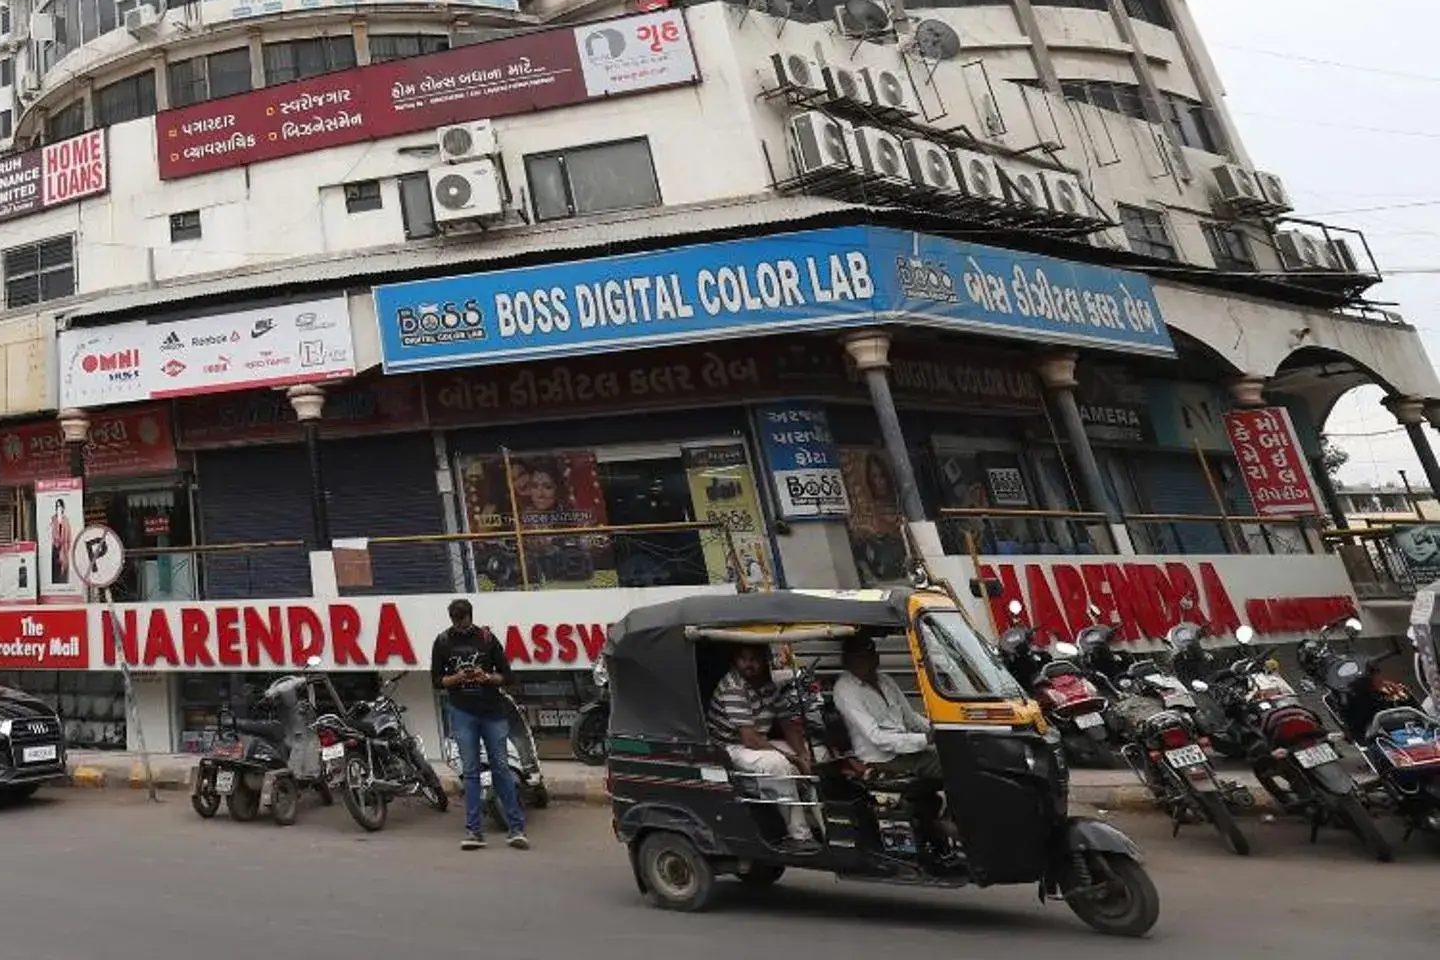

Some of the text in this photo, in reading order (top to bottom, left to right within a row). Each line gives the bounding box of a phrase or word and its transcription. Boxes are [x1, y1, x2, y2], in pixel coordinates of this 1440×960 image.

[280, 88, 352, 115] સ્વરોજગાર
[182, 114, 236, 135] પગારદાર
[47, 134, 101, 174] HOME
[47, 161, 103, 201] LOANS
[495, 250, 876, 337] BOSS DIGITAL COLOR LAB
[82, 348, 139, 373] OMNI
[437, 377, 500, 411] બોસ
[629, 365, 696, 395] કલર
[700, 352, 759, 387] લેબ
[1079, 405, 1140, 426] AMERA
[980, 562, 1242, 648] NARENDRA
[21, 616, 44, 636] The
[102, 602, 417, 667] NARENDRA
[49, 636, 79, 657] Mall
